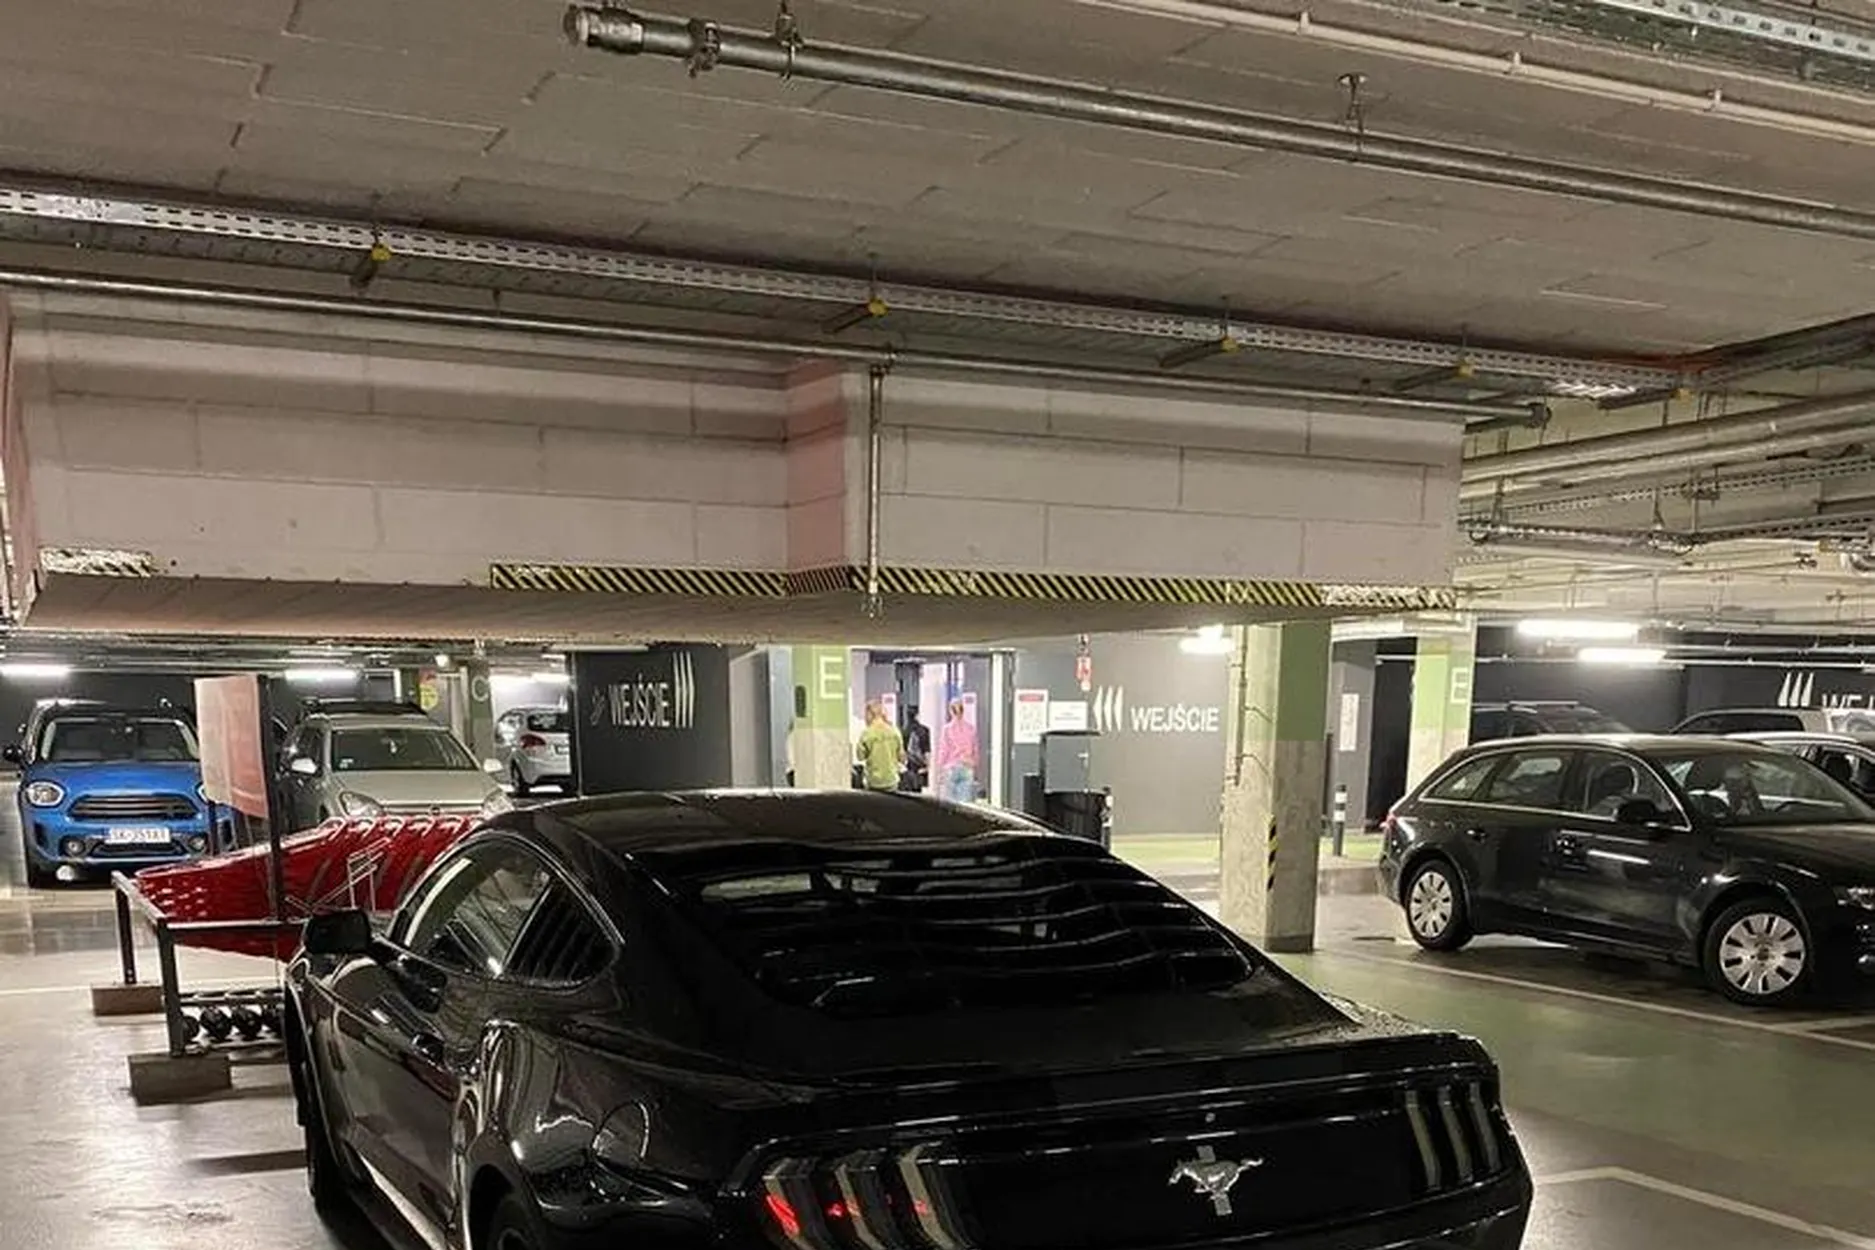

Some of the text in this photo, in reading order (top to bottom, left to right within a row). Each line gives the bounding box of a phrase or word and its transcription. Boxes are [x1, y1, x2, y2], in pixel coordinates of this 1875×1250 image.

[818, 655, 844, 699] E
[1450, 667, 1469, 703] E
[1130, 703, 1219, 732] WEJŚCIE
